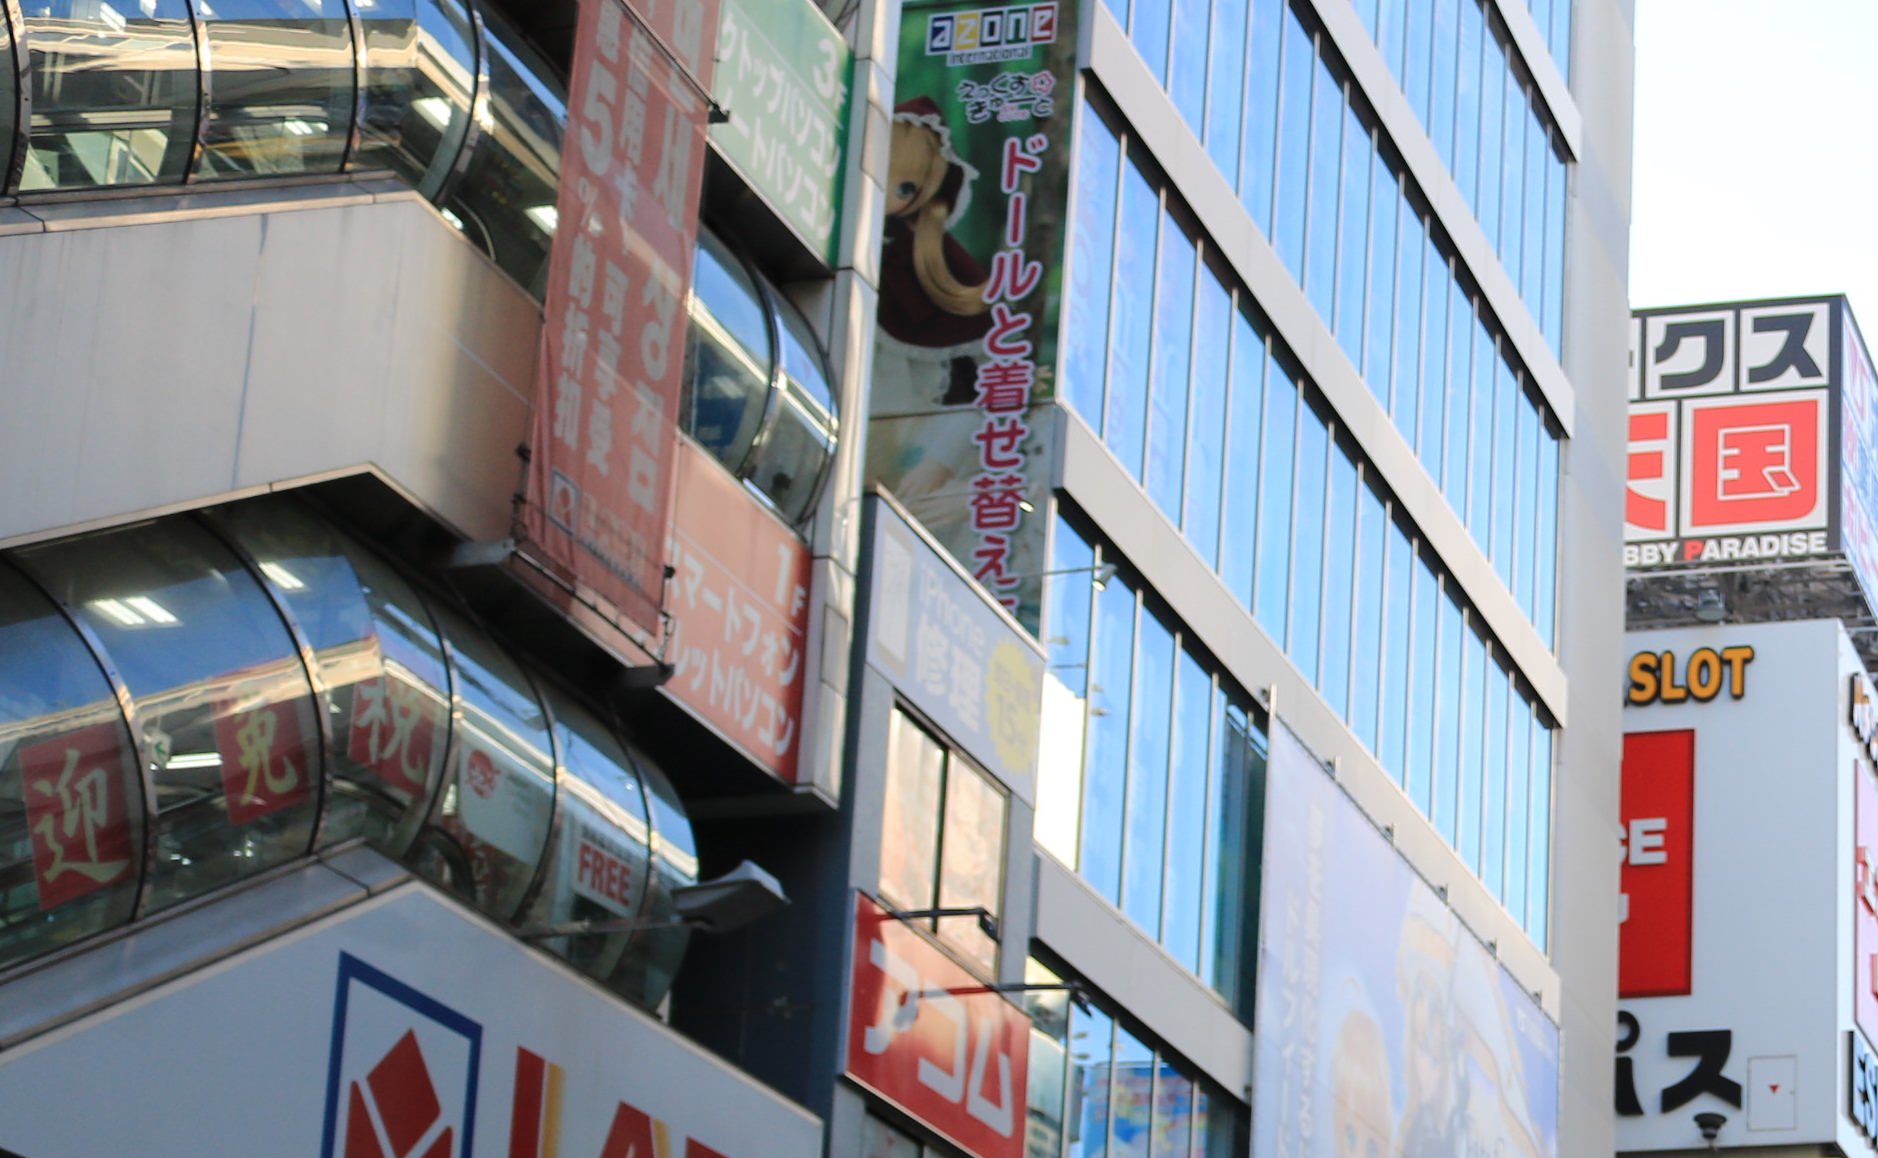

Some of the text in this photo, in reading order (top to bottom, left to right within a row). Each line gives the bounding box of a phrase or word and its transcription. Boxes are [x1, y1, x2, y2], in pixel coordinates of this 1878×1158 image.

[929, 5, 1056, 52] azone
[971, 137, 1047, 613] ドールと着せ替え
[1628, 311, 1824, 391] クス
[1684, 531, 1828, 561] PARADISE
[668, 539, 799, 686] マートフォン
[1628, 645, 1755, 703] SLOT
[235, 697, 300, 806] 免
[33, 746, 132, 884] 迎
[576, 841, 633, 908] FREE
